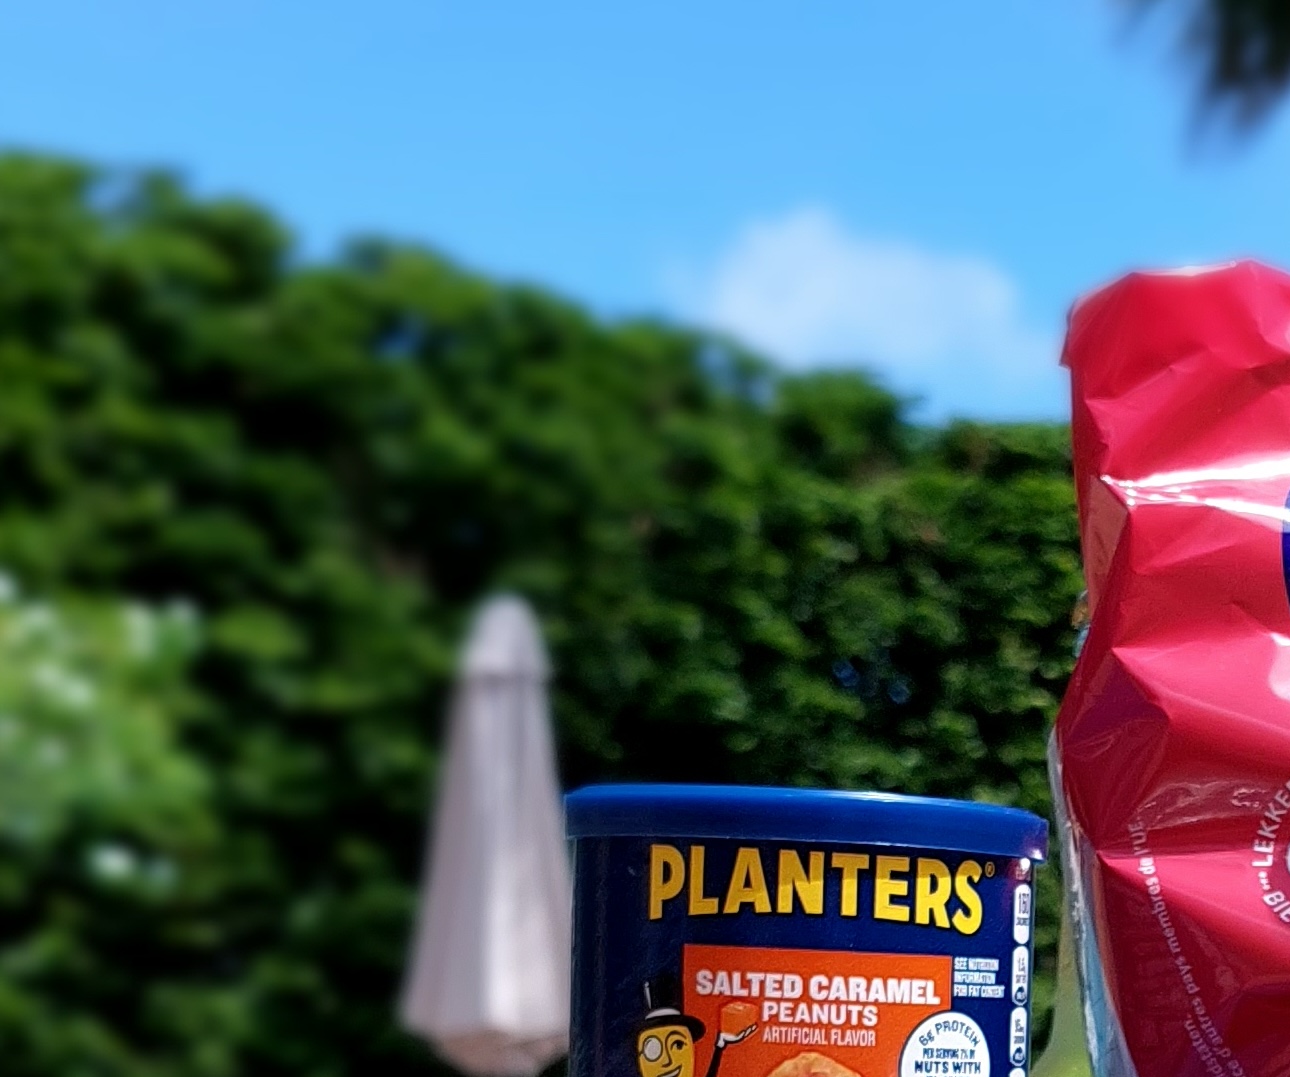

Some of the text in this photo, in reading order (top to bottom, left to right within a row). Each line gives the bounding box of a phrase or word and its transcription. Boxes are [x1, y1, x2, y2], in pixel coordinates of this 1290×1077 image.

[648, 844, 983, 935] PLANTERS
[695, 969, 941, 1006] SALTED CARAMEL
[762, 1001, 878, 1027] PEANUTS
[762, 1025, 877, 1047] ARTIFICIAL FLAVOR
[934, 1020, 980, 1047] PROTEIN
[914, 1060, 981, 1074] NUTS WITH
